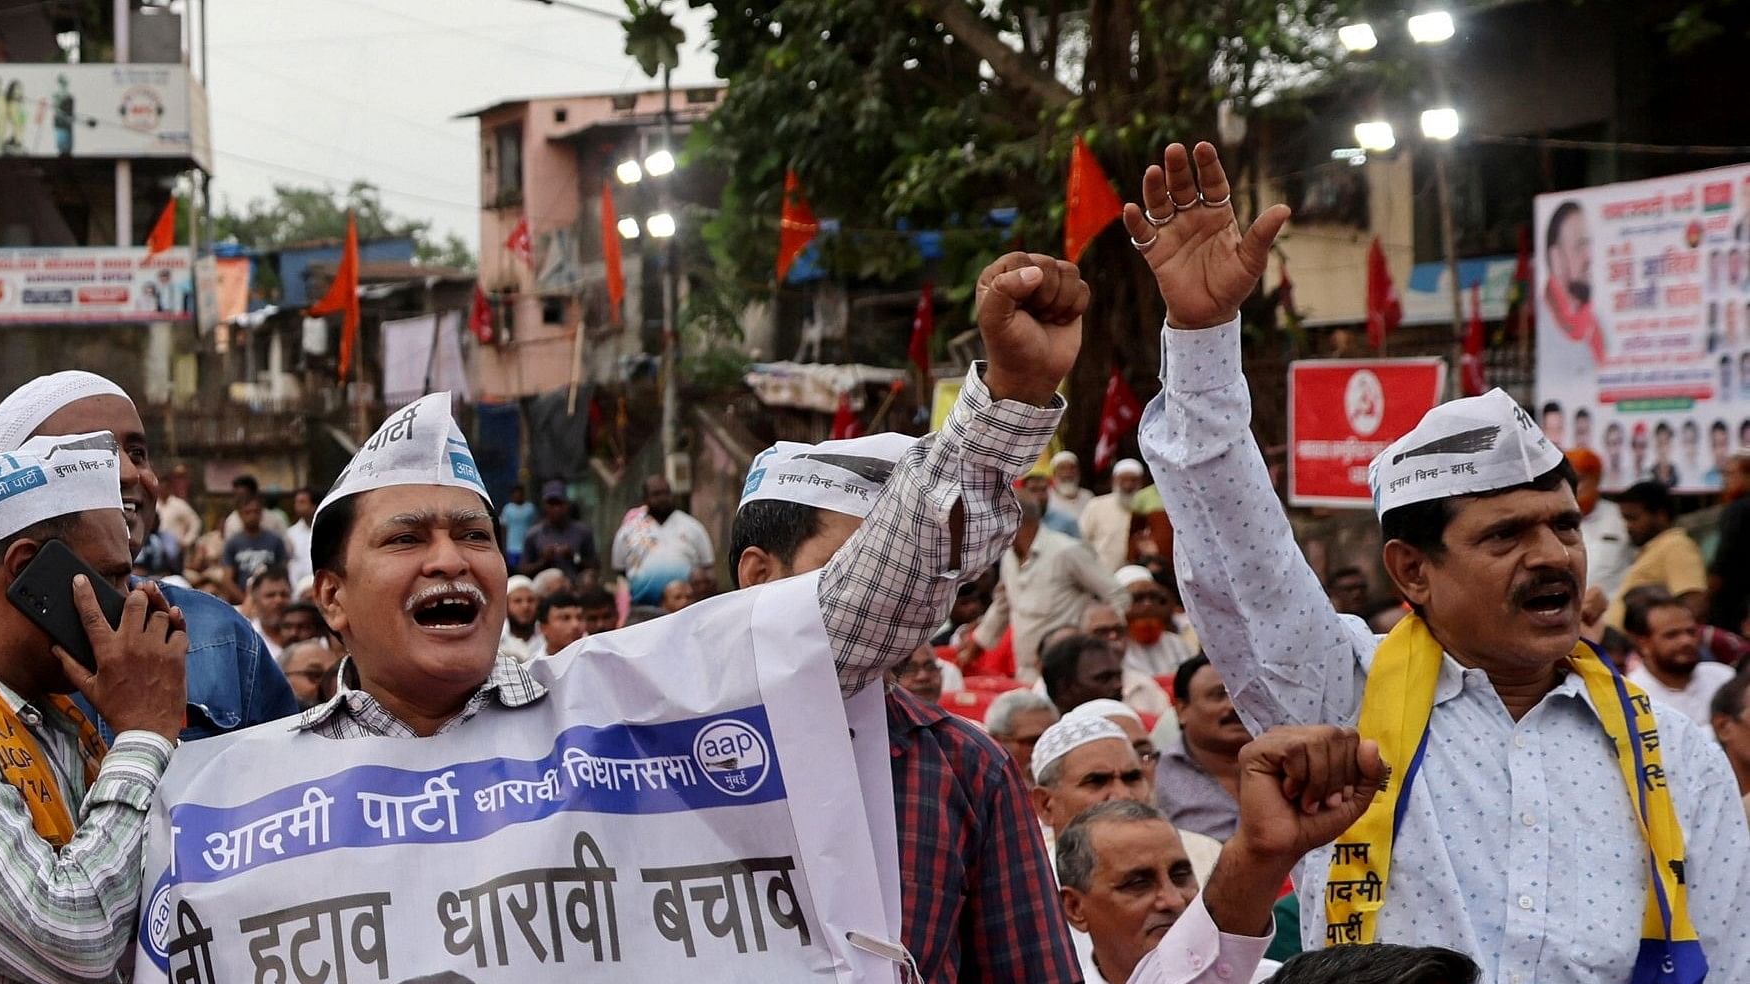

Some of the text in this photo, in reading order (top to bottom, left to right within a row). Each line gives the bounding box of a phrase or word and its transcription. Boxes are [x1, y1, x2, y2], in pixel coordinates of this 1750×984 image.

[10, 469, 39, 490] पार्टी
[55, 463, 77, 478] चुनाव
[778, 473, 804, 485] चुनाव
[1389, 475, 1411, 493] चुनाव
[704, 732, 754, 758] aap
[724, 769, 748, 790] मुंबई
[202, 746, 698, 874] आदमी पार्टी धारावी विधानसभा
[435, 830, 623, 970] धारावी
[640, 854, 814, 960] बचाव
[1327, 912, 1364, 945] पार्टी
